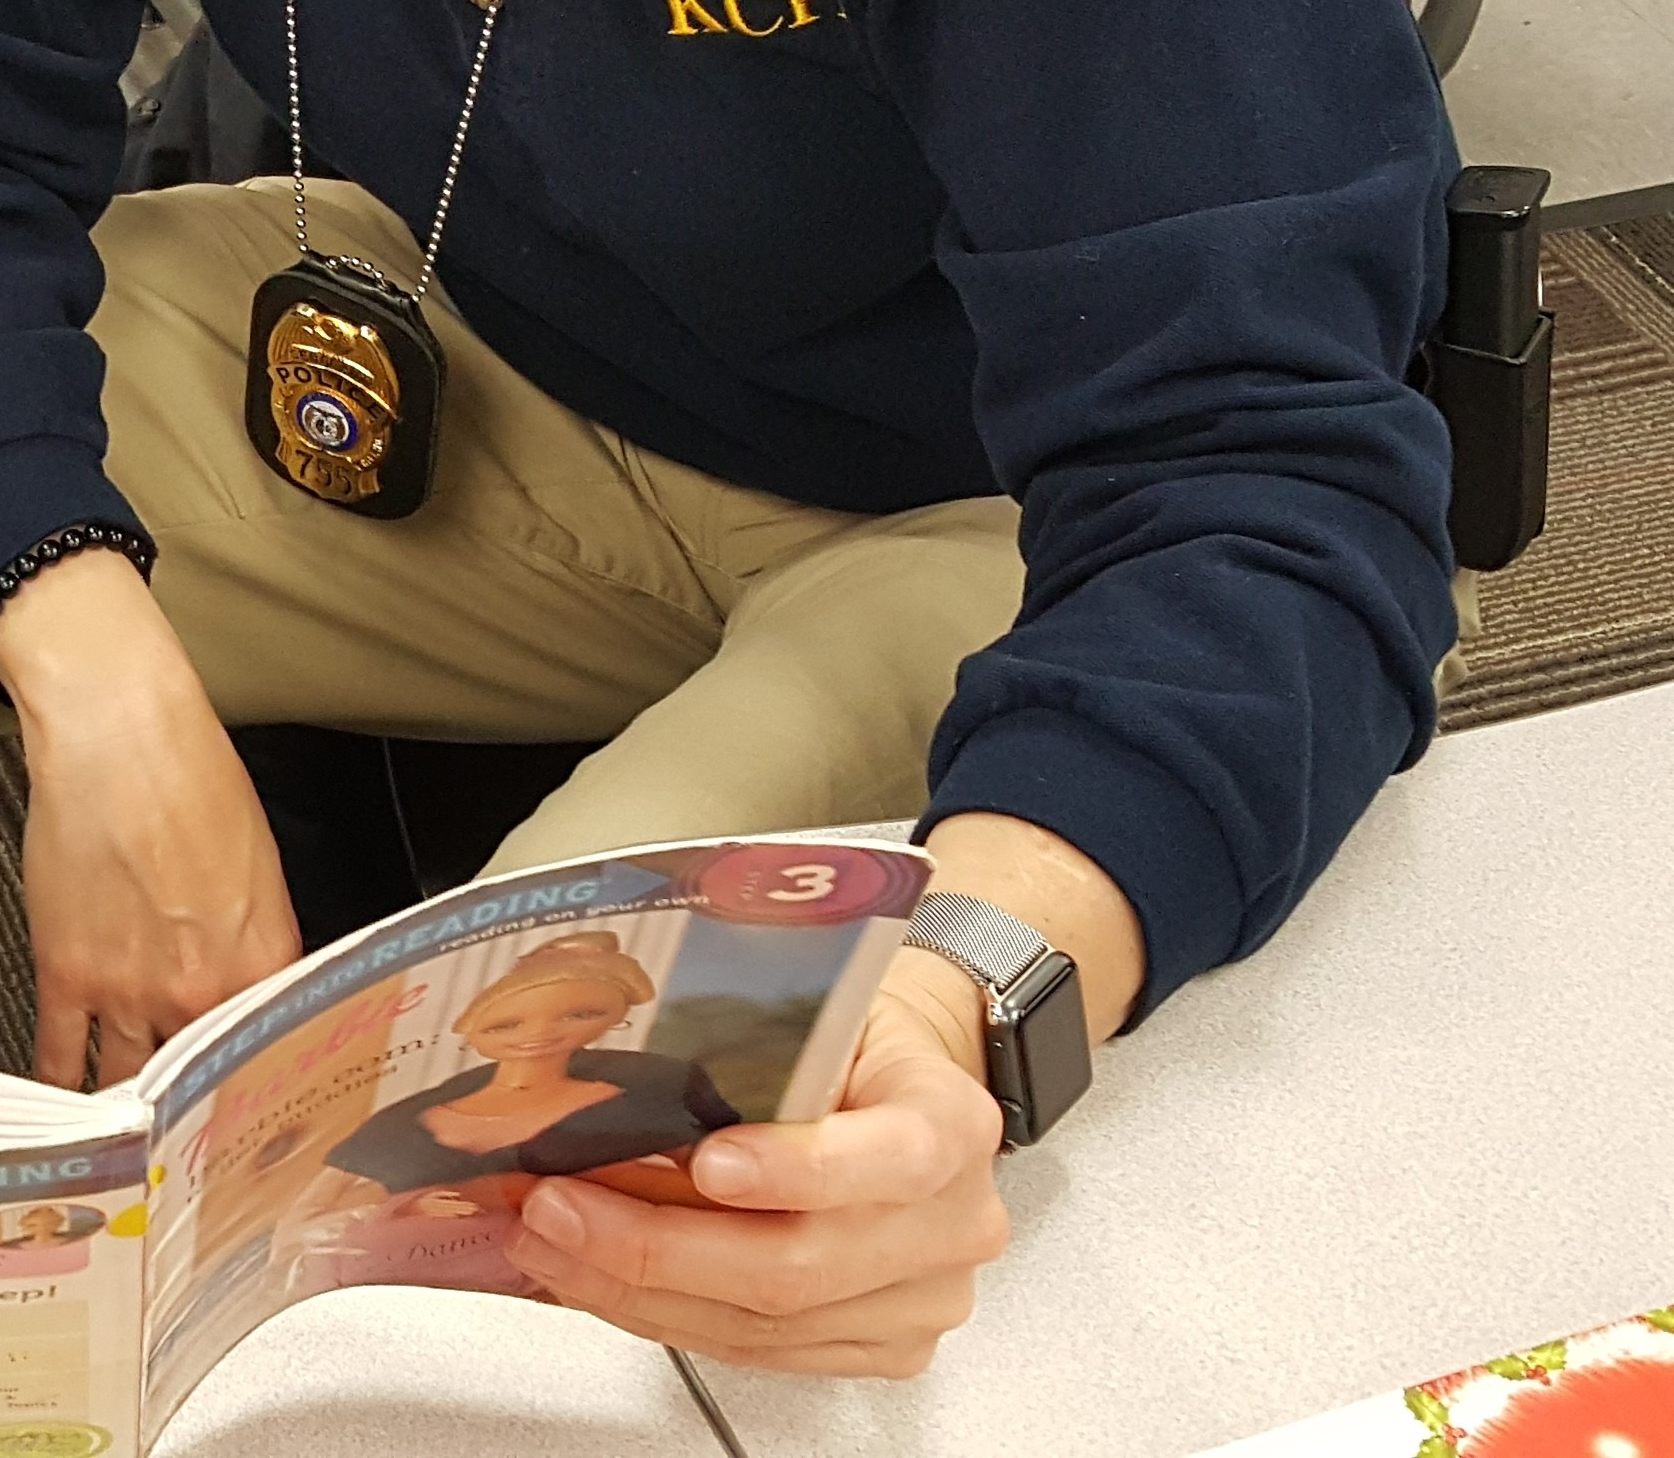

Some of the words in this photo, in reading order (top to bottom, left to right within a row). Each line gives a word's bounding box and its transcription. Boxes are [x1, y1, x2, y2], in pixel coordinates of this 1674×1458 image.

[276, 367, 387, 423] POLICE
[767, 864, 837, 903] 3
[372, 878, 603, 969] READING
[439, 916, 537, 953] reading
[544, 908, 577, 924] on
[585, 897, 647, 918] your
[654, 893, 712, 908] own
